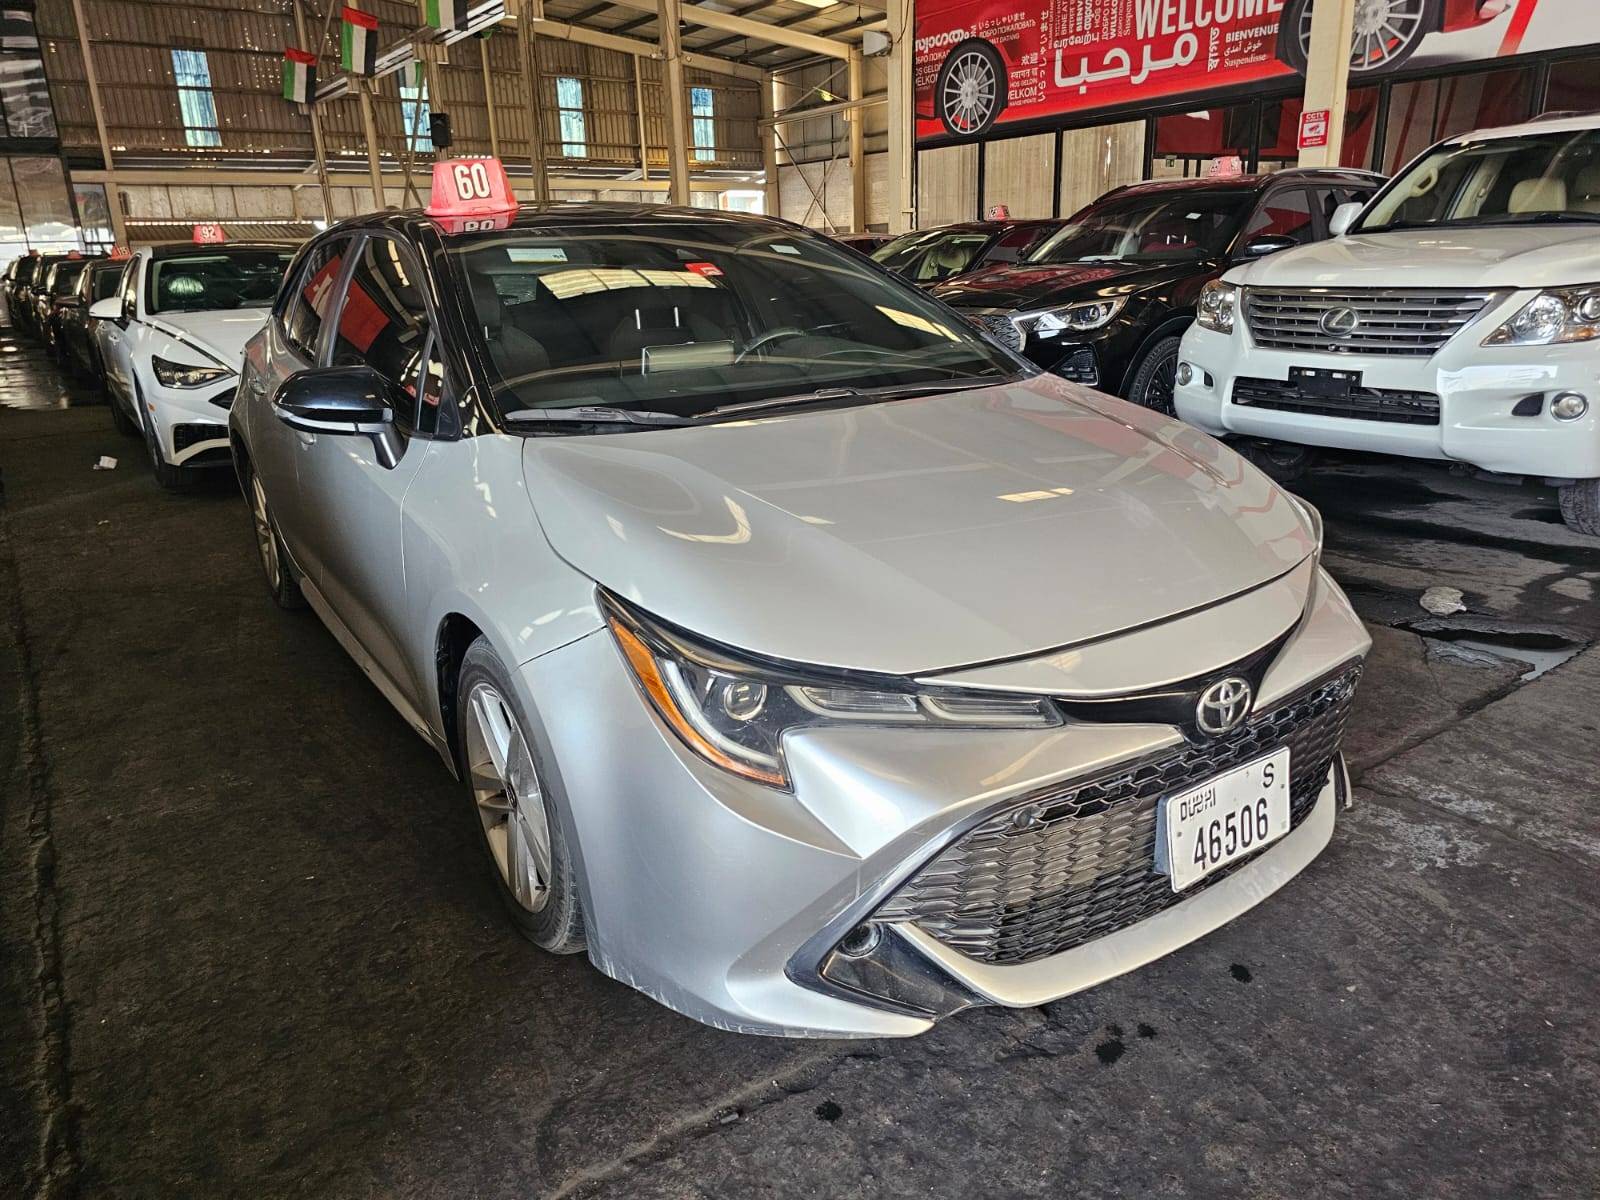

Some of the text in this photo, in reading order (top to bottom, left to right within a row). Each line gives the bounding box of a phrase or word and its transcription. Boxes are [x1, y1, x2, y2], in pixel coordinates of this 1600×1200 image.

[1135, 0, 1284, 40] WELCO
[1225, 23, 1280, 43] BIENVENUE
[1054, 32, 1198, 95] مرحبا
[1306, 111, 1325, 120] CCTV
[453, 162, 491, 200] 60
[202, 225, 216, 238] 92
[1262, 762, 1275, 789] S
[1193, 797, 1268, 870] 46506
